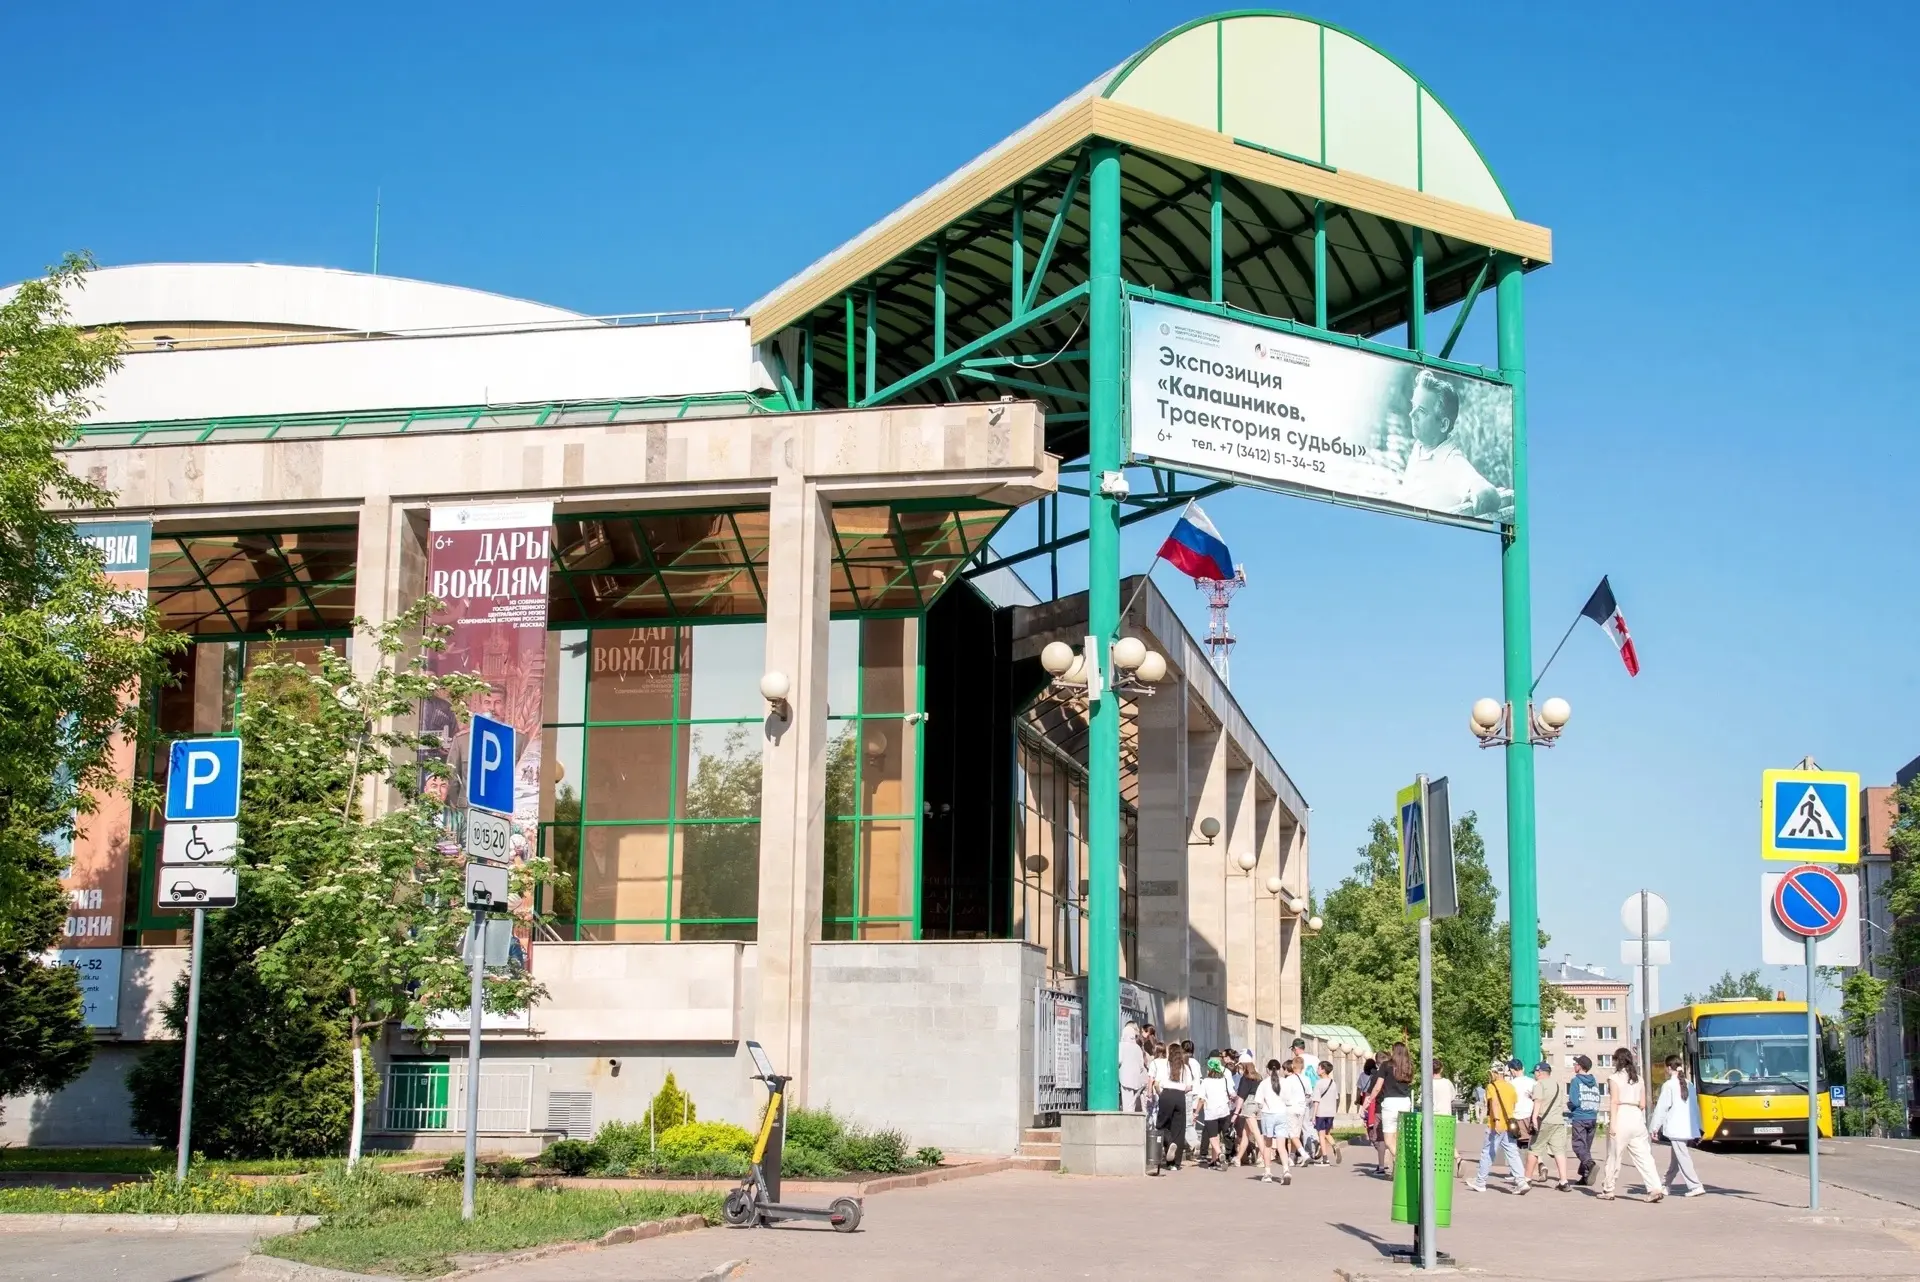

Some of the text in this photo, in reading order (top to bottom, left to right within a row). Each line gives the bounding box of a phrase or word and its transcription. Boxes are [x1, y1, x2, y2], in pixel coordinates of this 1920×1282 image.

[1159, 346, 1282, 390] Экспозиция
[1158, 375, 1306, 422] «Калашников.
[1157, 398, 1367, 457] Траектория судьбы»
[1157, 429, 1173, 442] 6+
[1191, 438, 1326, 473] тел. +7 (3412) 51-34-52
[435, 535, 454, 550] 6+
[475, 530, 549, 566] ДАРЫ
[433, 566, 548, 600] ВОЖДЯМ
[185, 751, 221, 810] P
[480, 730, 502, 797] P
[473, 827, 505, 849] 10 15 20
